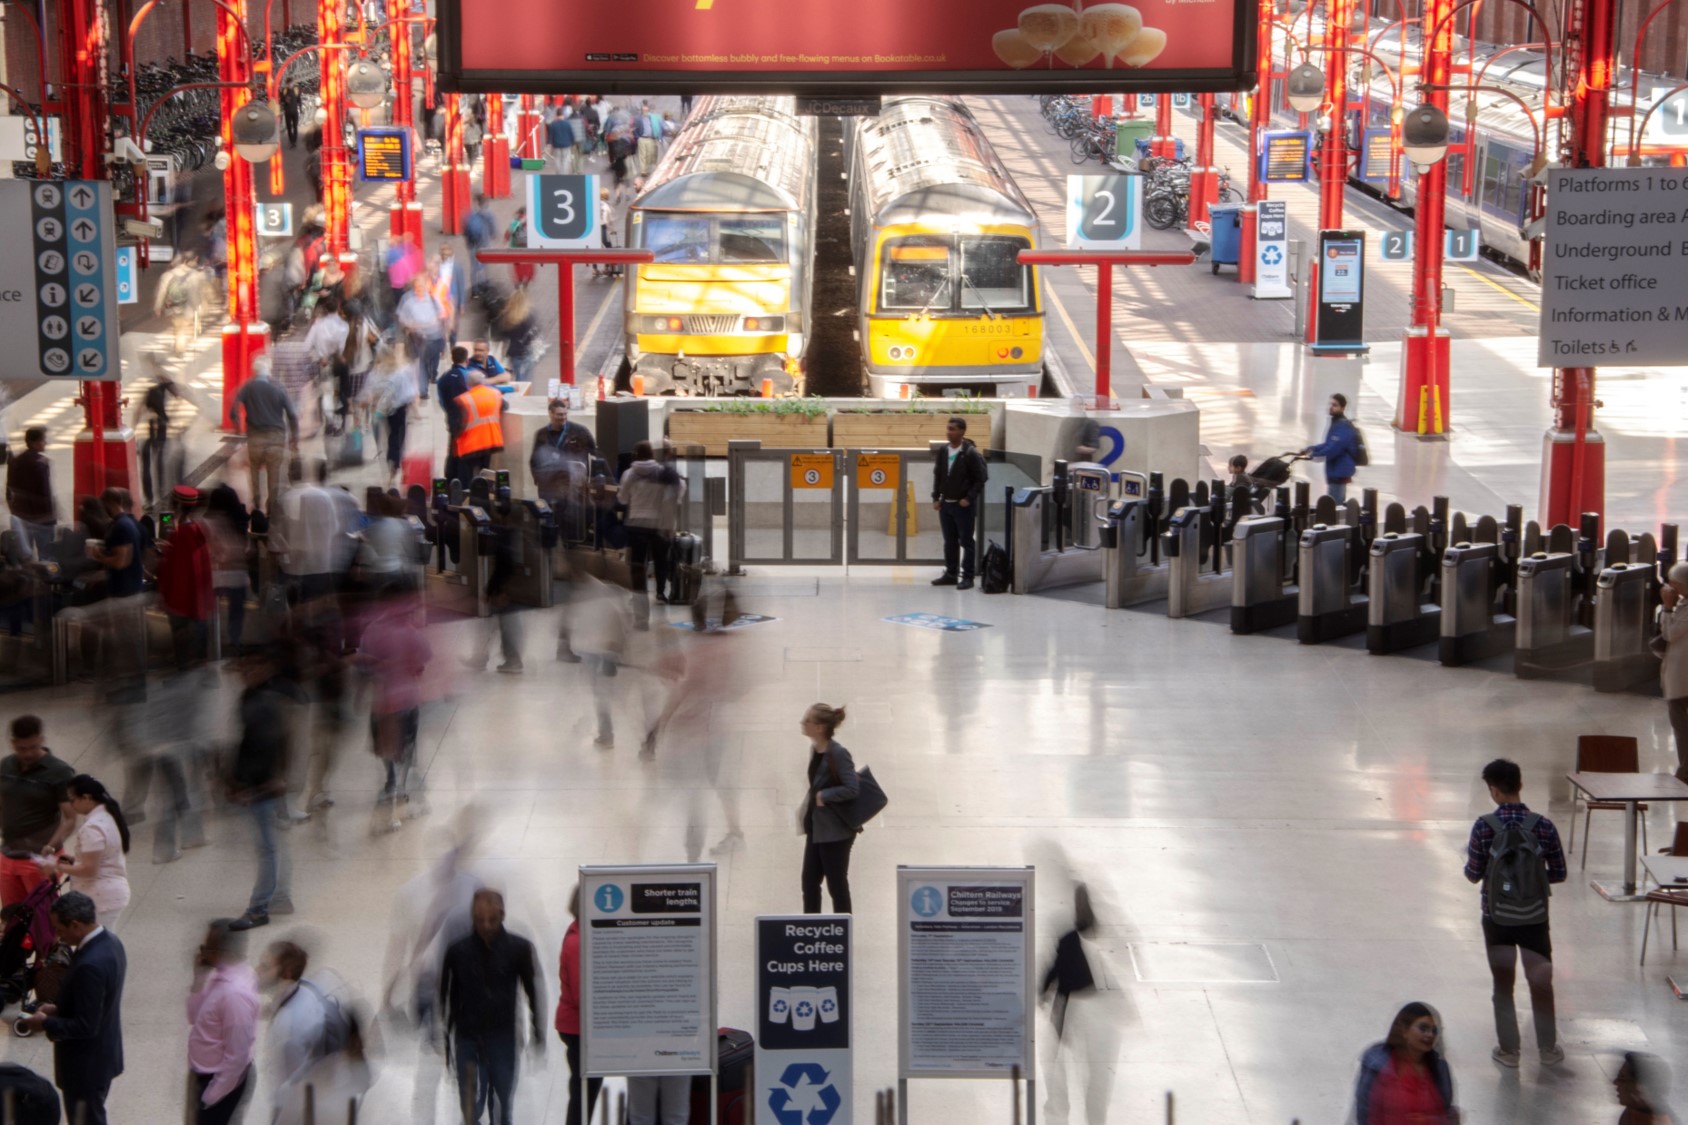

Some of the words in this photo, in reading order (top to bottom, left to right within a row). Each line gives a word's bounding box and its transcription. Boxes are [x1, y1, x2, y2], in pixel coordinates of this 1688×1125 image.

[643, 54, 679, 62] Discover
[681, 54, 729, 62] bottomless
[730, 54, 759, 64] bubbly
[761, 54, 778, 62] and
[779, 54, 830, 64] free-flowing
[832, 55, 860, 63] menus
[874, 54, 947, 63] Bookatable.co.uk
[805, 102, 869, 114] JCDecaux
[1673, 98, 1686, 125] 1
[1559, 176, 1640, 193] Platforms
[1646, 177, 1653, 191] 1
[1660, 177, 1677, 191] to
[553, 189, 575, 225] 3
[1093, 190, 1116, 226] 2
[268, 209, 281, 227] 3
[1556, 209, 1635, 228] Boarding
[1639, 211, 1676, 225] area
[1389, 236, 1402, 254] 2
[1456, 235, 1465, 253] 1
[1555, 241, 1672, 261] Underground
[1554, 274, 1606, 290] Ticket
[1609, 274, 1658, 290] office
[1551, 306, 1653, 322] Information
[1657, 306, 1671, 321] &
[964, 325, 1012, 334] 168003
[1551, 339, 1606, 355] Toilets
[808, 471, 816, 483] 3
[874, 471, 882, 483] 3
[644, 889, 676, 897] Shorter
[677, 888, 698, 897] train
[950, 891, 984, 899] Chiltern
[985, 891, 1022, 901] Railways
[666, 898, 698, 907] lengths
[950, 899, 978, 907] Changes
[950, 906, 986, 914] September
[650, 919, 676, 928] update
[785, 924, 844, 939] Recycle
[793, 941, 844, 955] Coffee
[766, 960, 806, 975] Cups
[808, 959, 844, 972] Here
